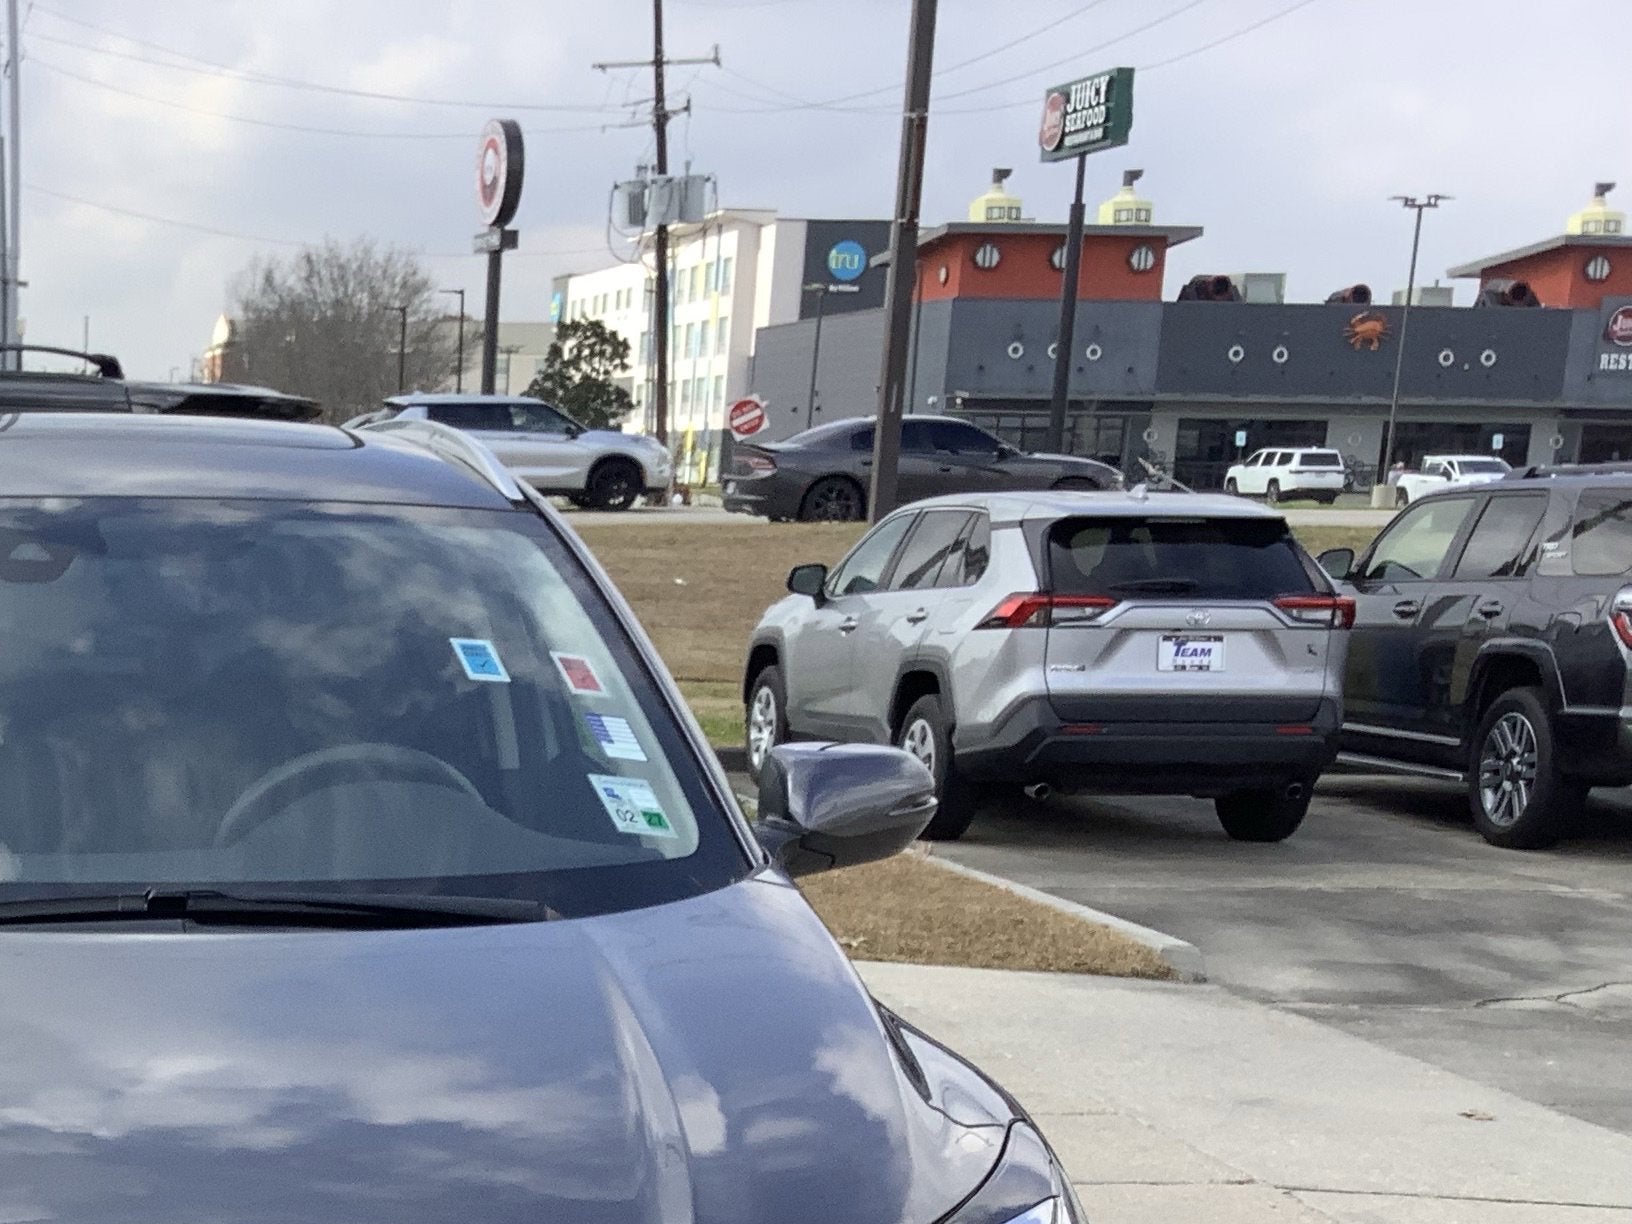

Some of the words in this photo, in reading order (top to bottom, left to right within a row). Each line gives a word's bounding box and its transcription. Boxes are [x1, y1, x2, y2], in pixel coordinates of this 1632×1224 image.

[1067, 75, 1109, 112] JUICY
[1065, 105, 1106, 133] SEAFOOD
[829, 249, 859, 269] tru
[1173, 640, 1212, 658] TEAM
